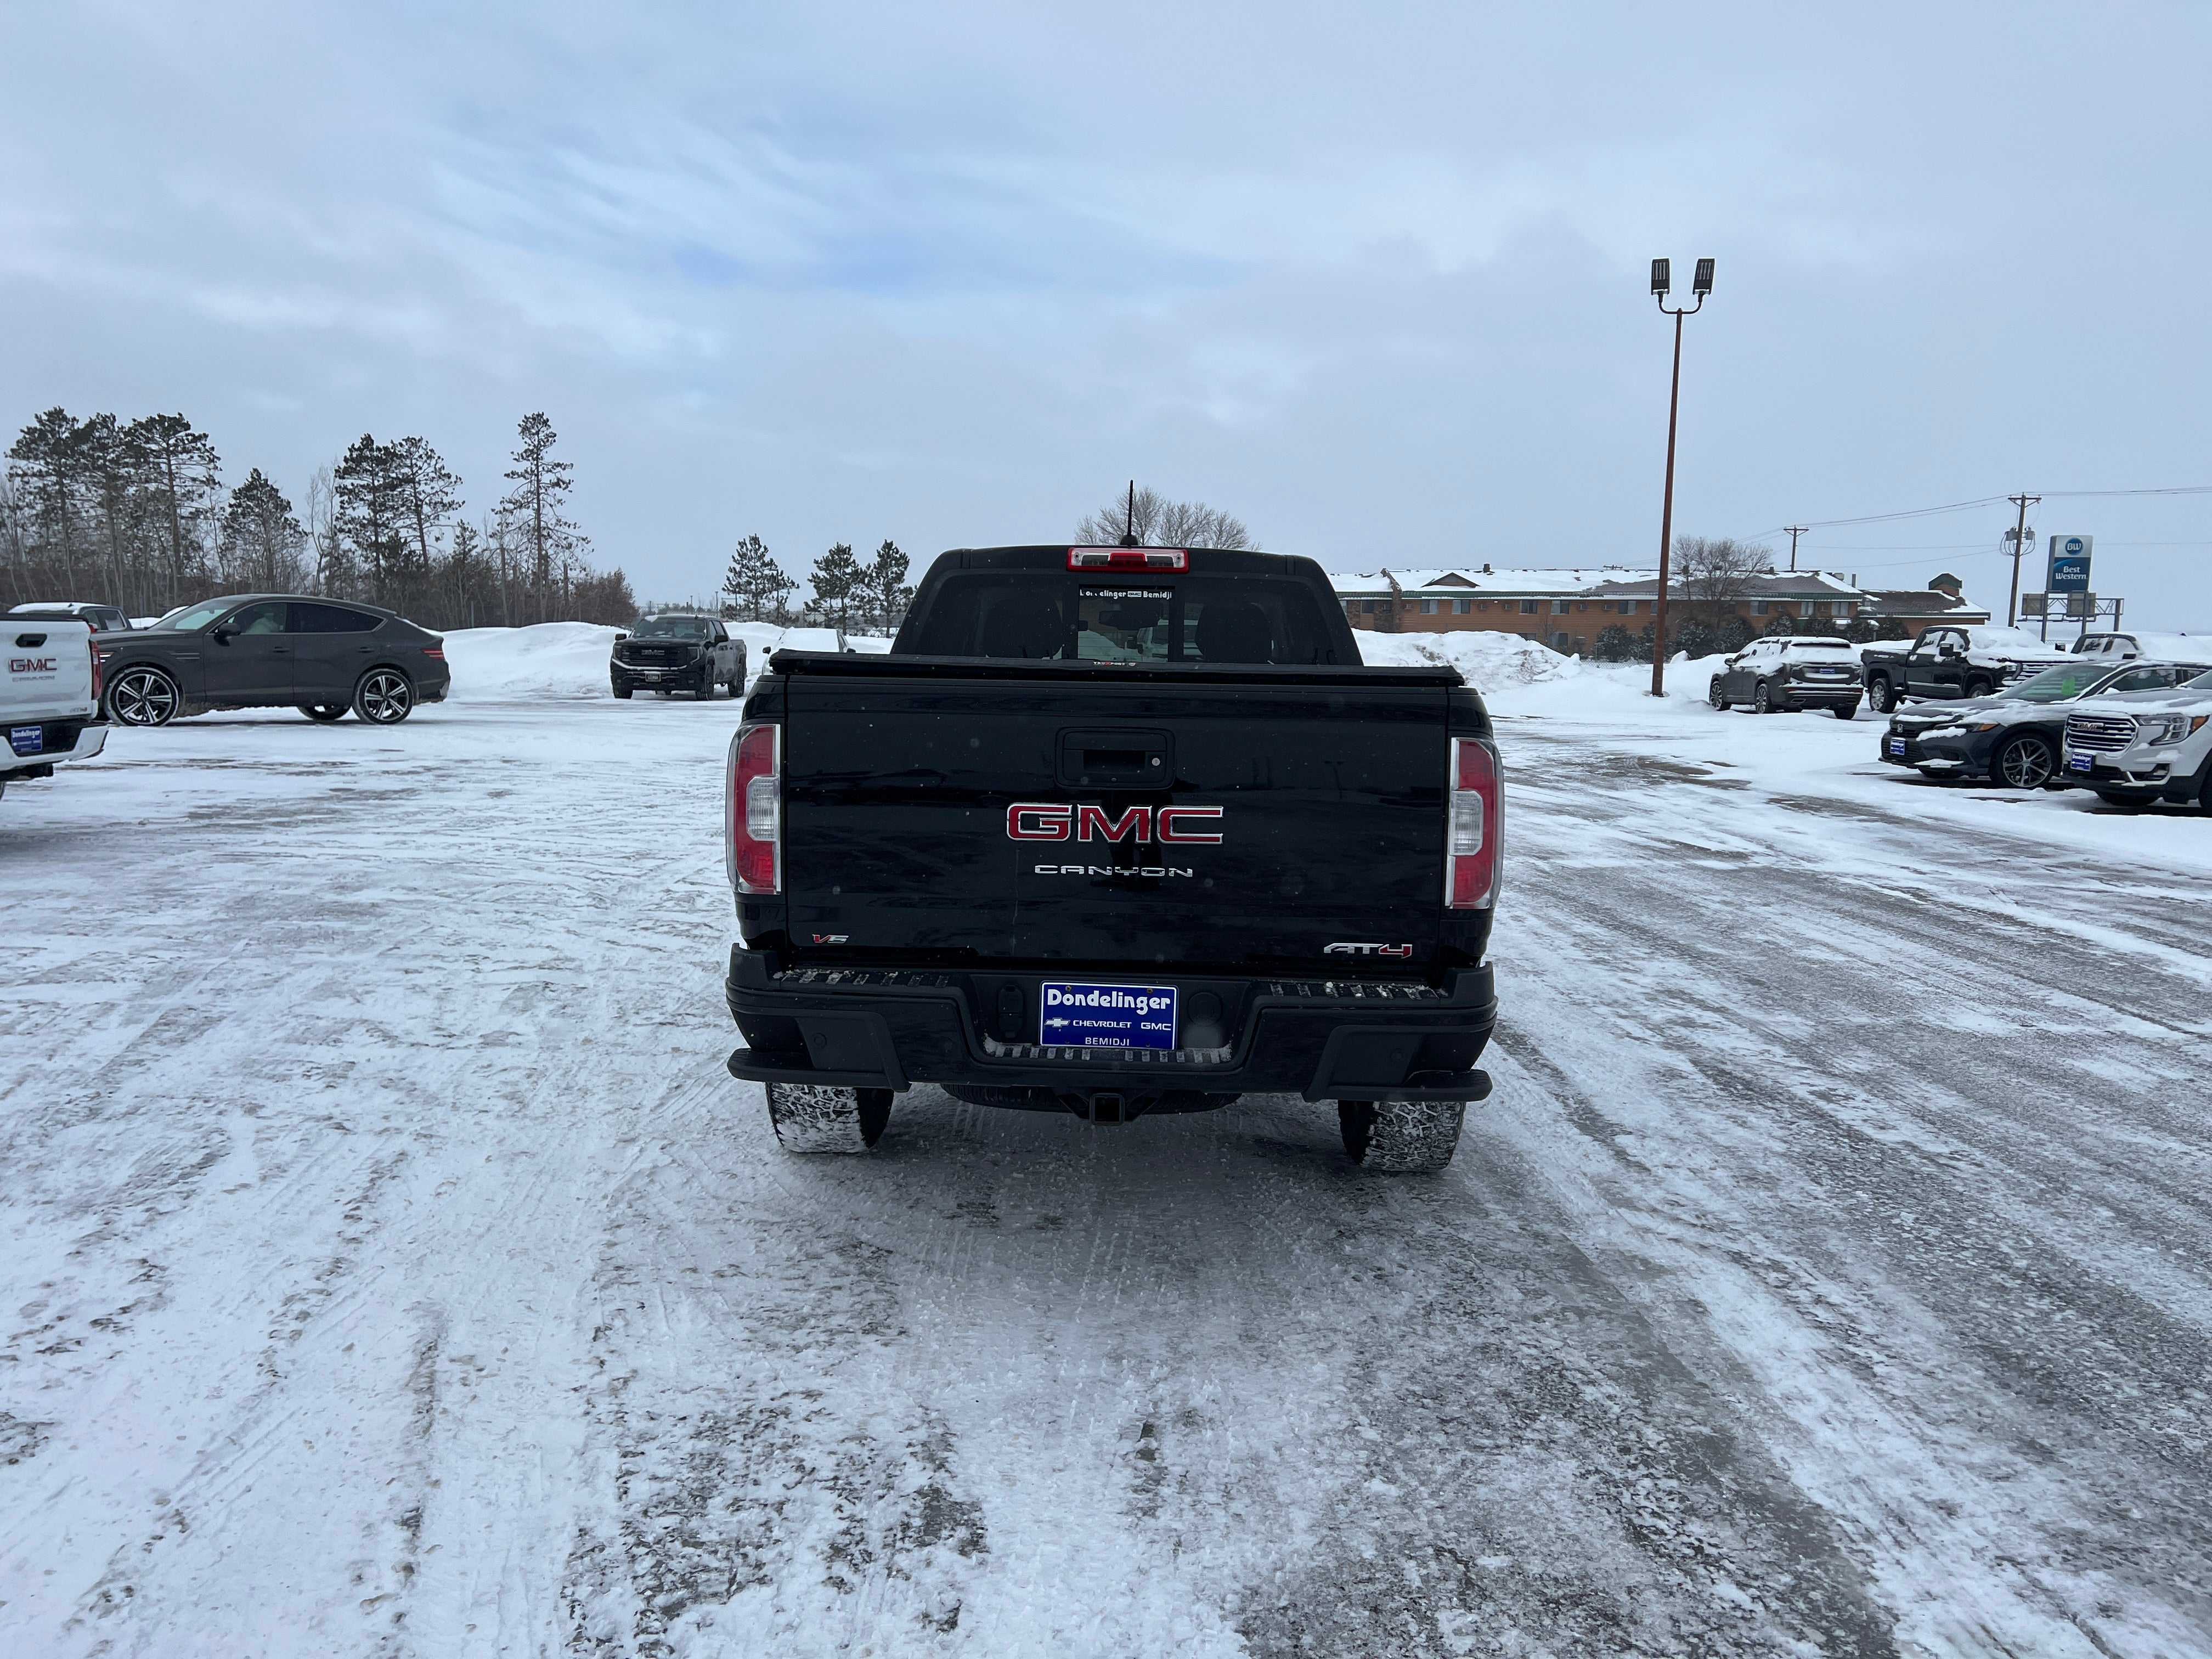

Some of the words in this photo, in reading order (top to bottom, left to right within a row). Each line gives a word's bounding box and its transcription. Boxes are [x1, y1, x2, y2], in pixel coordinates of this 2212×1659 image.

[1143, 591, 1172, 600] Bemidji
[9, 658, 57, 673] GMC
[2077, 723, 2104, 732] GMC
[1007, 803, 1223, 844] GMC
[1035, 865, 1193, 877] CANYON
[812, 934, 849, 944] V6
[1324, 943, 1412, 959] AT4
[1047, 989, 1170, 1015] Dondelinger
[1073, 1020, 1132, 1028] CHEVROLET
[1141, 1022, 1171, 1031] GMC
[1085, 1037, 1130, 1046] BEMIDJI
